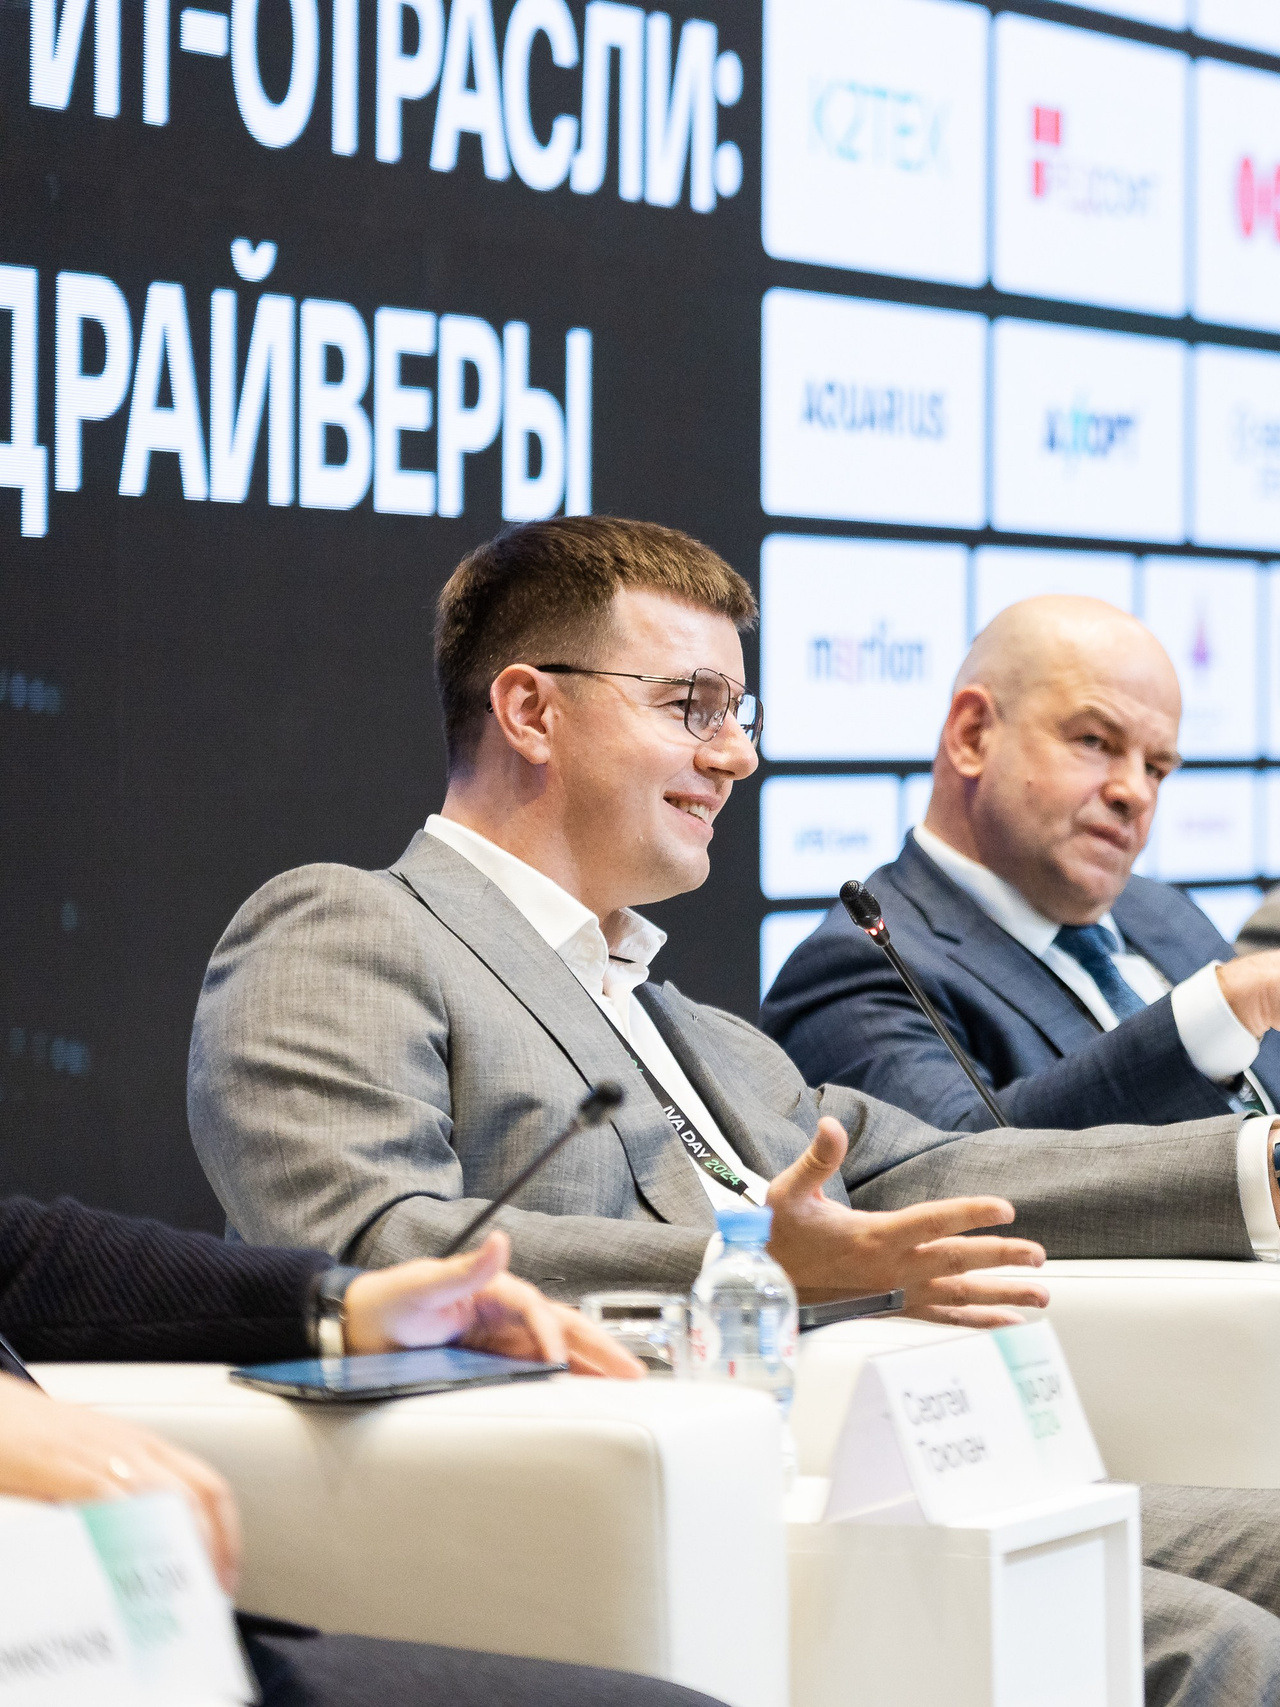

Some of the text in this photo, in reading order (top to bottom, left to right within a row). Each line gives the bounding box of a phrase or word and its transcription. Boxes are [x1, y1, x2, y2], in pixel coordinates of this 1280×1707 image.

[663, 1105, 741, 1186] IVA DAY 2024
[903, 1377, 970, 1428] Сергей
